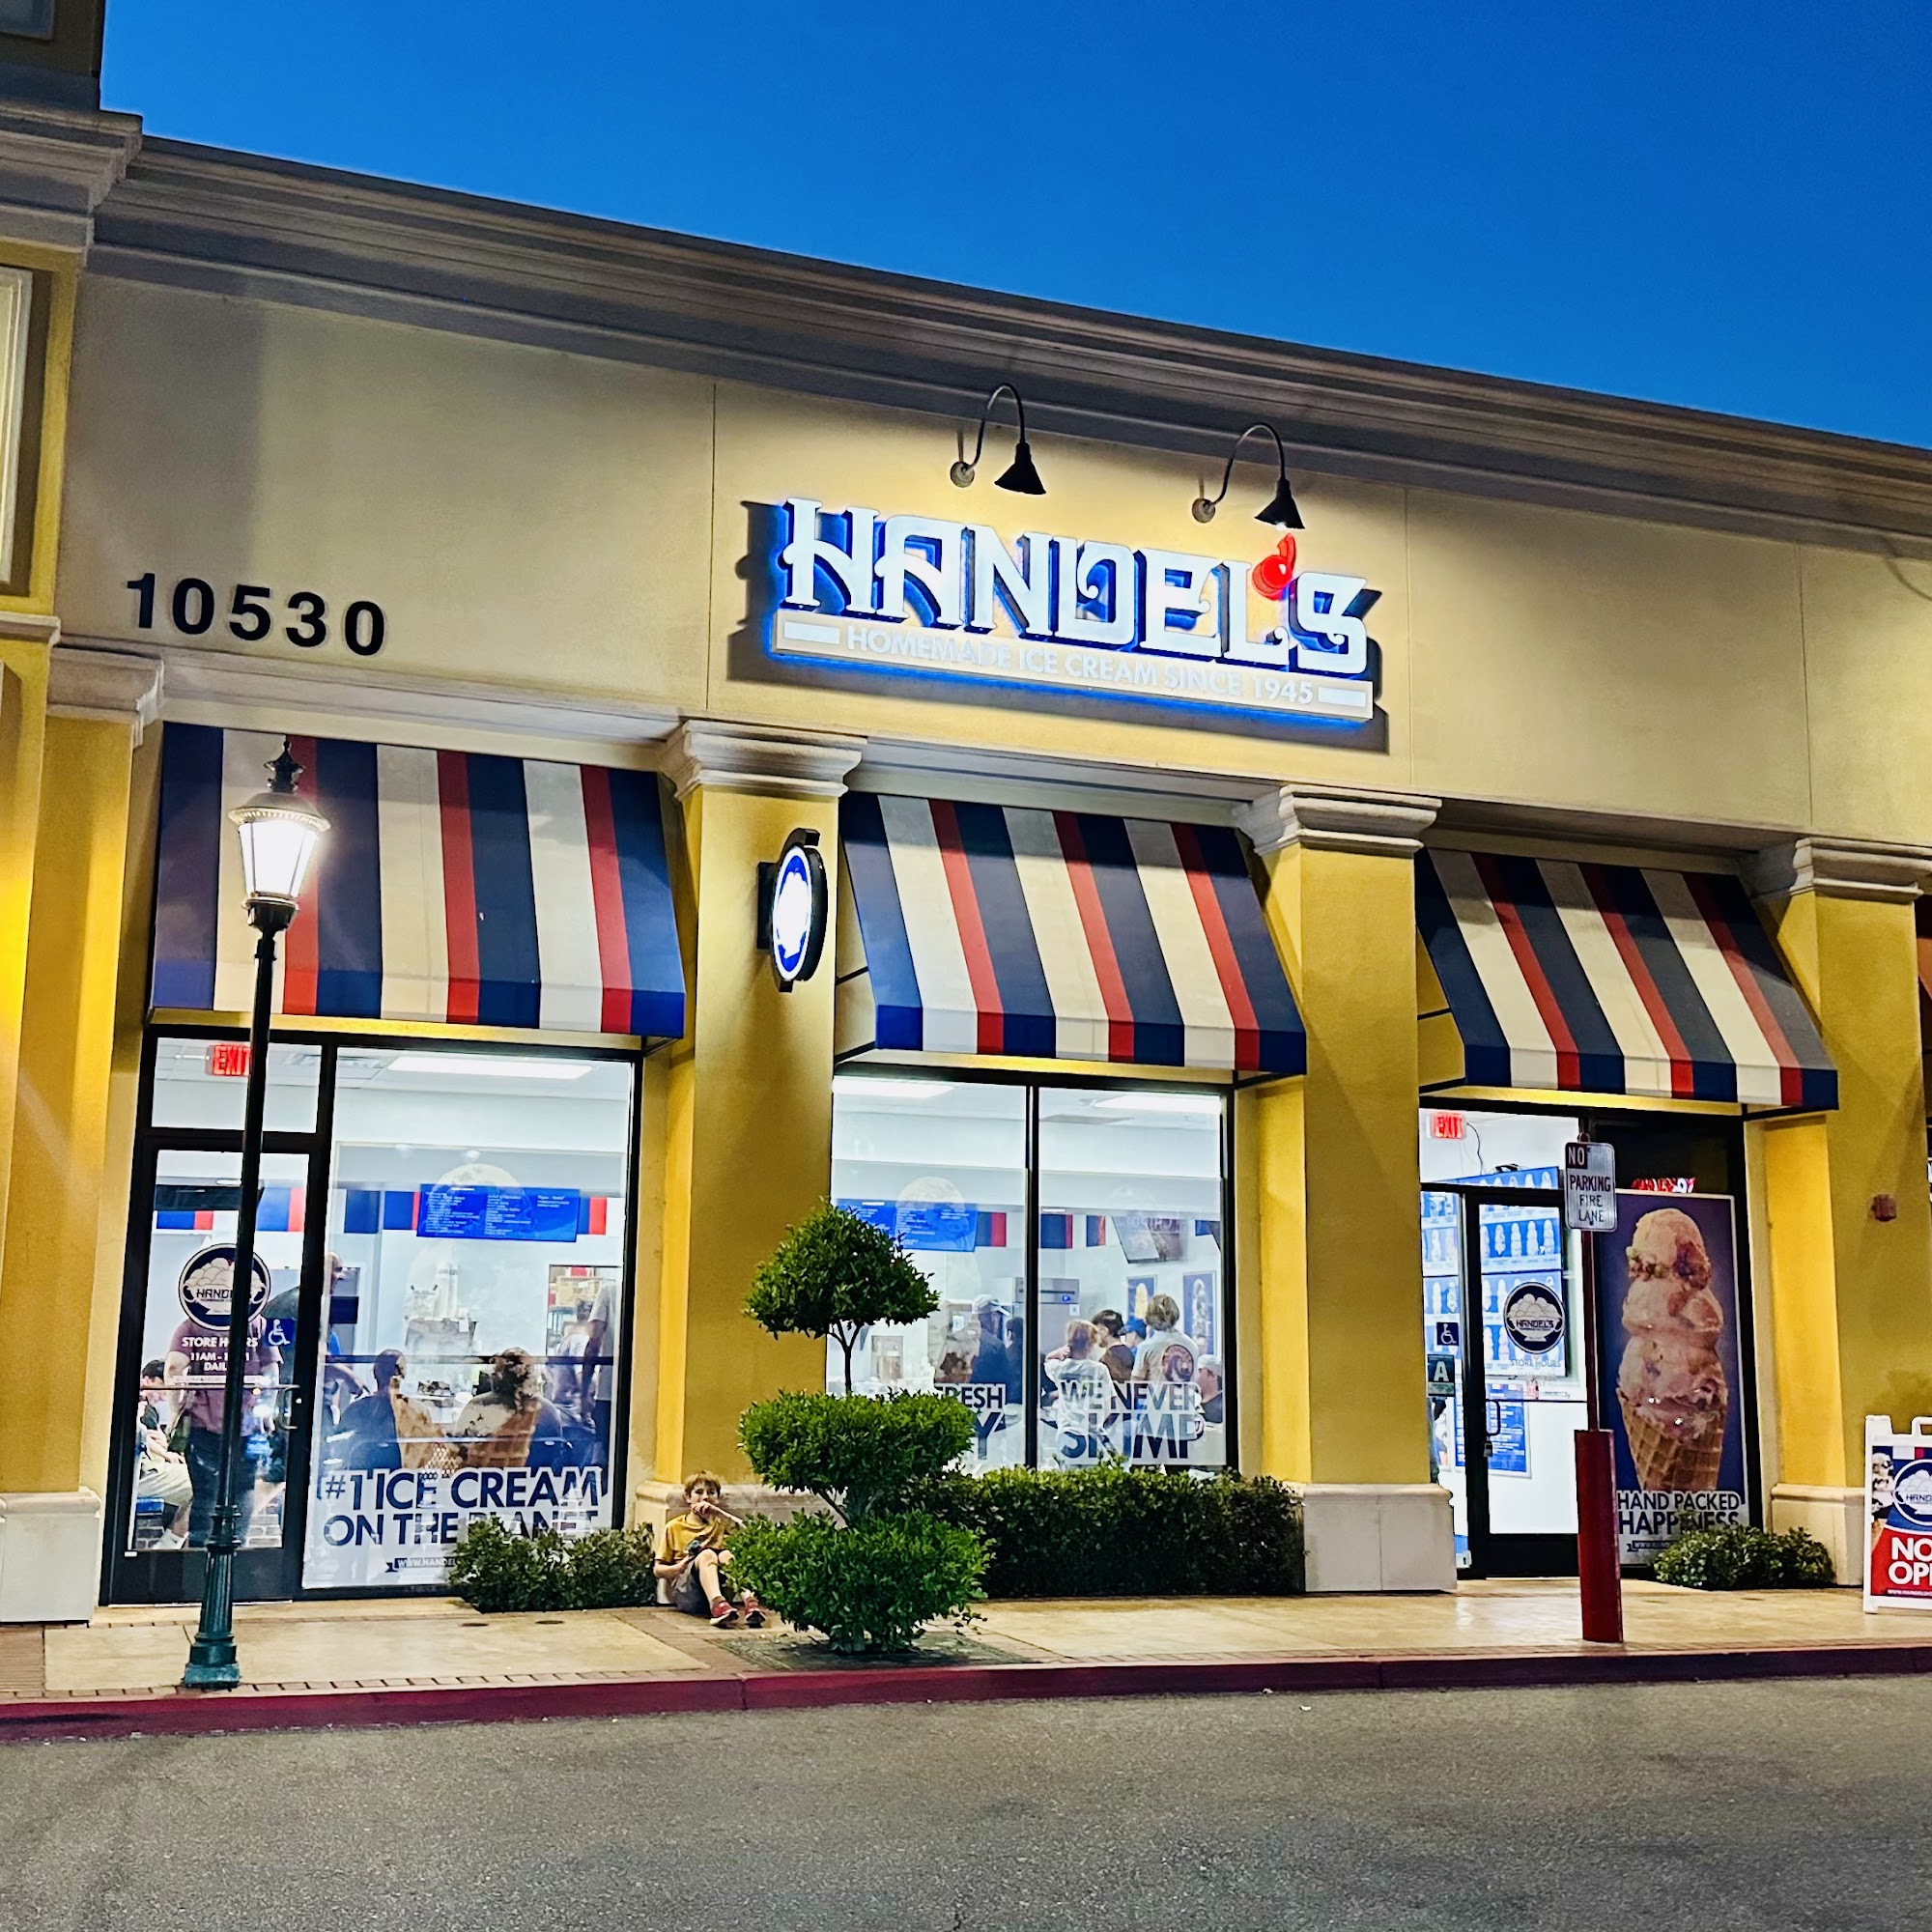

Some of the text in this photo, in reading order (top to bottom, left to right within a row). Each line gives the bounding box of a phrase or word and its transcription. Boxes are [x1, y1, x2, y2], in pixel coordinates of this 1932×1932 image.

[127, 573, 384, 656] 10530
[847, 625, 1314, 705] HOMEMADE ICE CREAM SINCE 1945
[213, 1045, 251, 1075] EXIT
[1435, 1114, 1463, 1138] EXIT
[1568, 1146, 1585, 1166] NO
[1570, 1175, 1610, 1192] PARKING
[1579, 1195, 1602, 1207] FIRE
[1578, 1209, 1604, 1222] LANE
[182, 1337, 258, 1348] STORE HRS
[190, 1352, 216, 1361] 11AM
[1434, 1361, 1449, 1381] A
[1061, 1382, 1198, 1410] WE NEVER
[1061, 1413, 1200, 1459] SKIMP
[326, 1471, 598, 1510] #1 ICE CREAM
[1617, 1492, 1740, 1510] HAND PACKED
[324, 1514, 384, 1546] ON
[392, 1512, 459, 1545] THE
[1618, 1511, 1739, 1535] HAPPNESS
